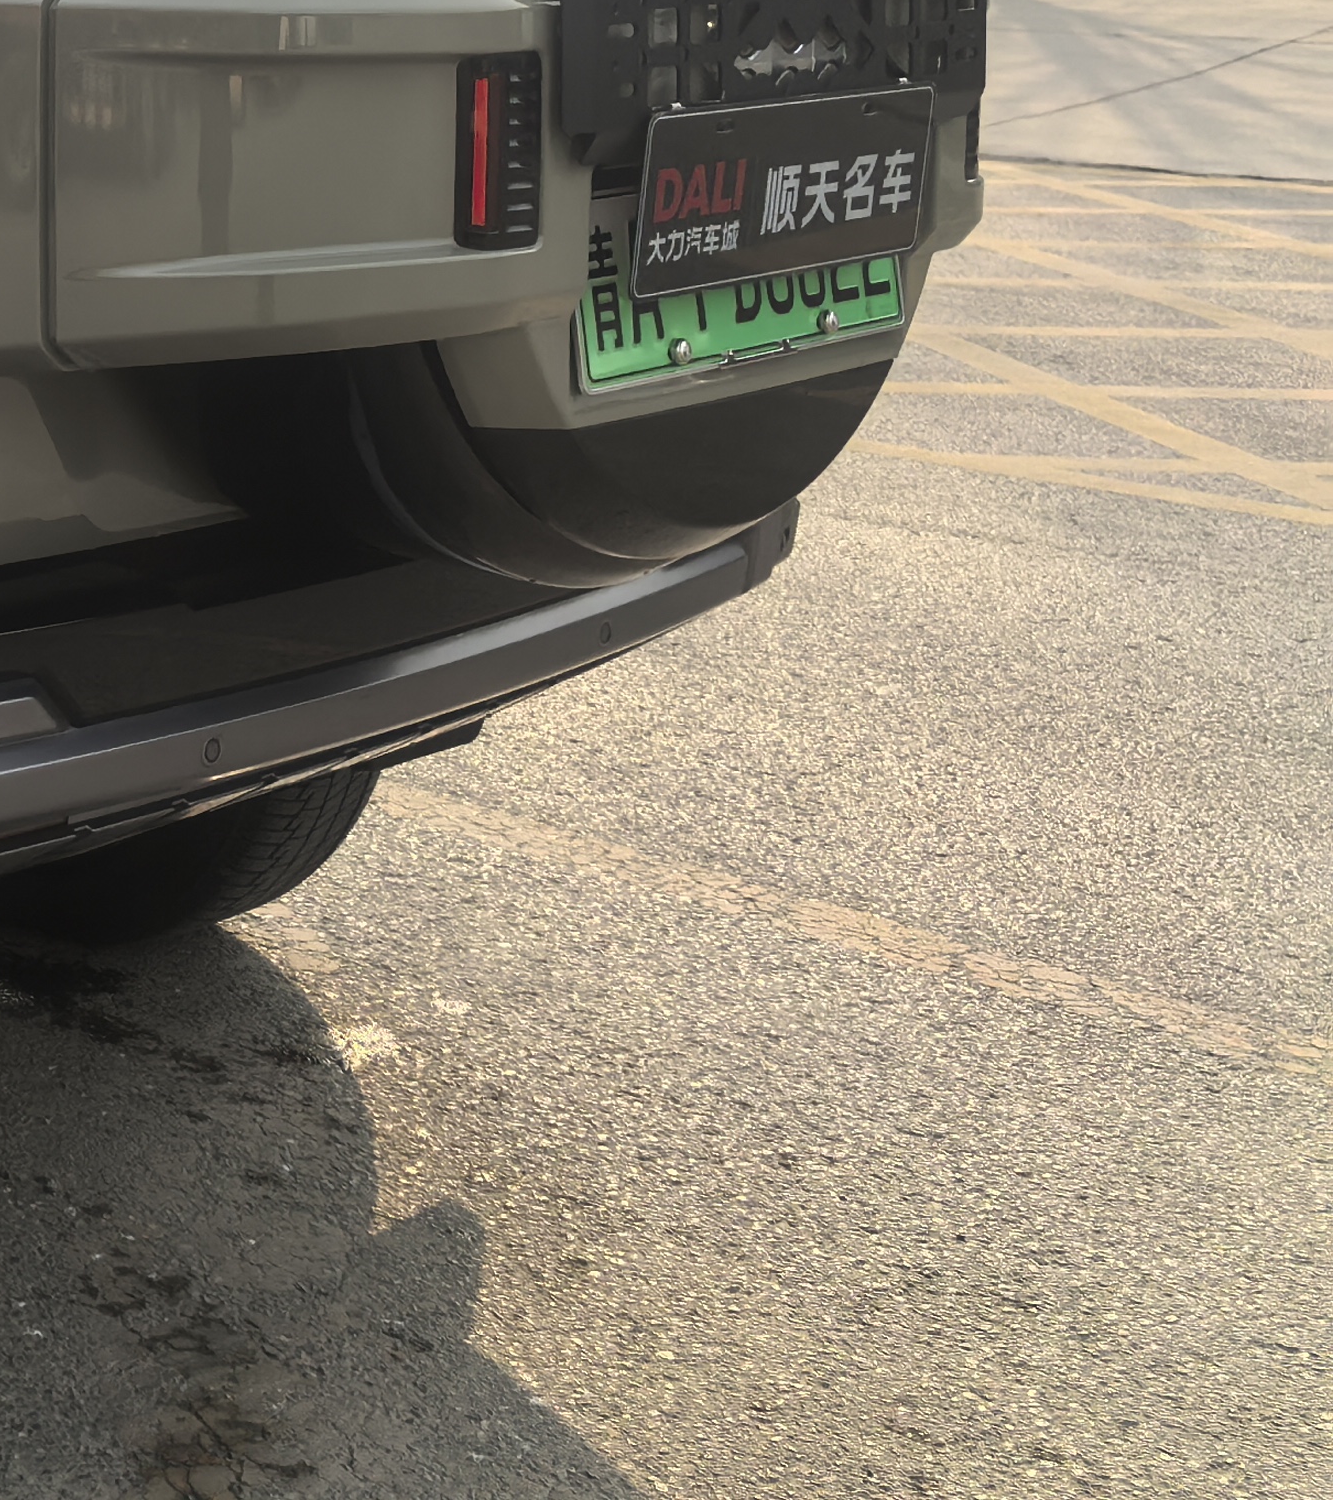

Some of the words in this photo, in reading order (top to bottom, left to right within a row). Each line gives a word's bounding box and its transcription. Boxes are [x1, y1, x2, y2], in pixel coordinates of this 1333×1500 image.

[653, 158, 748, 223] DALI
[760, 149, 915, 236] 顺天名车
[646, 219, 741, 267] 大力汽车城
